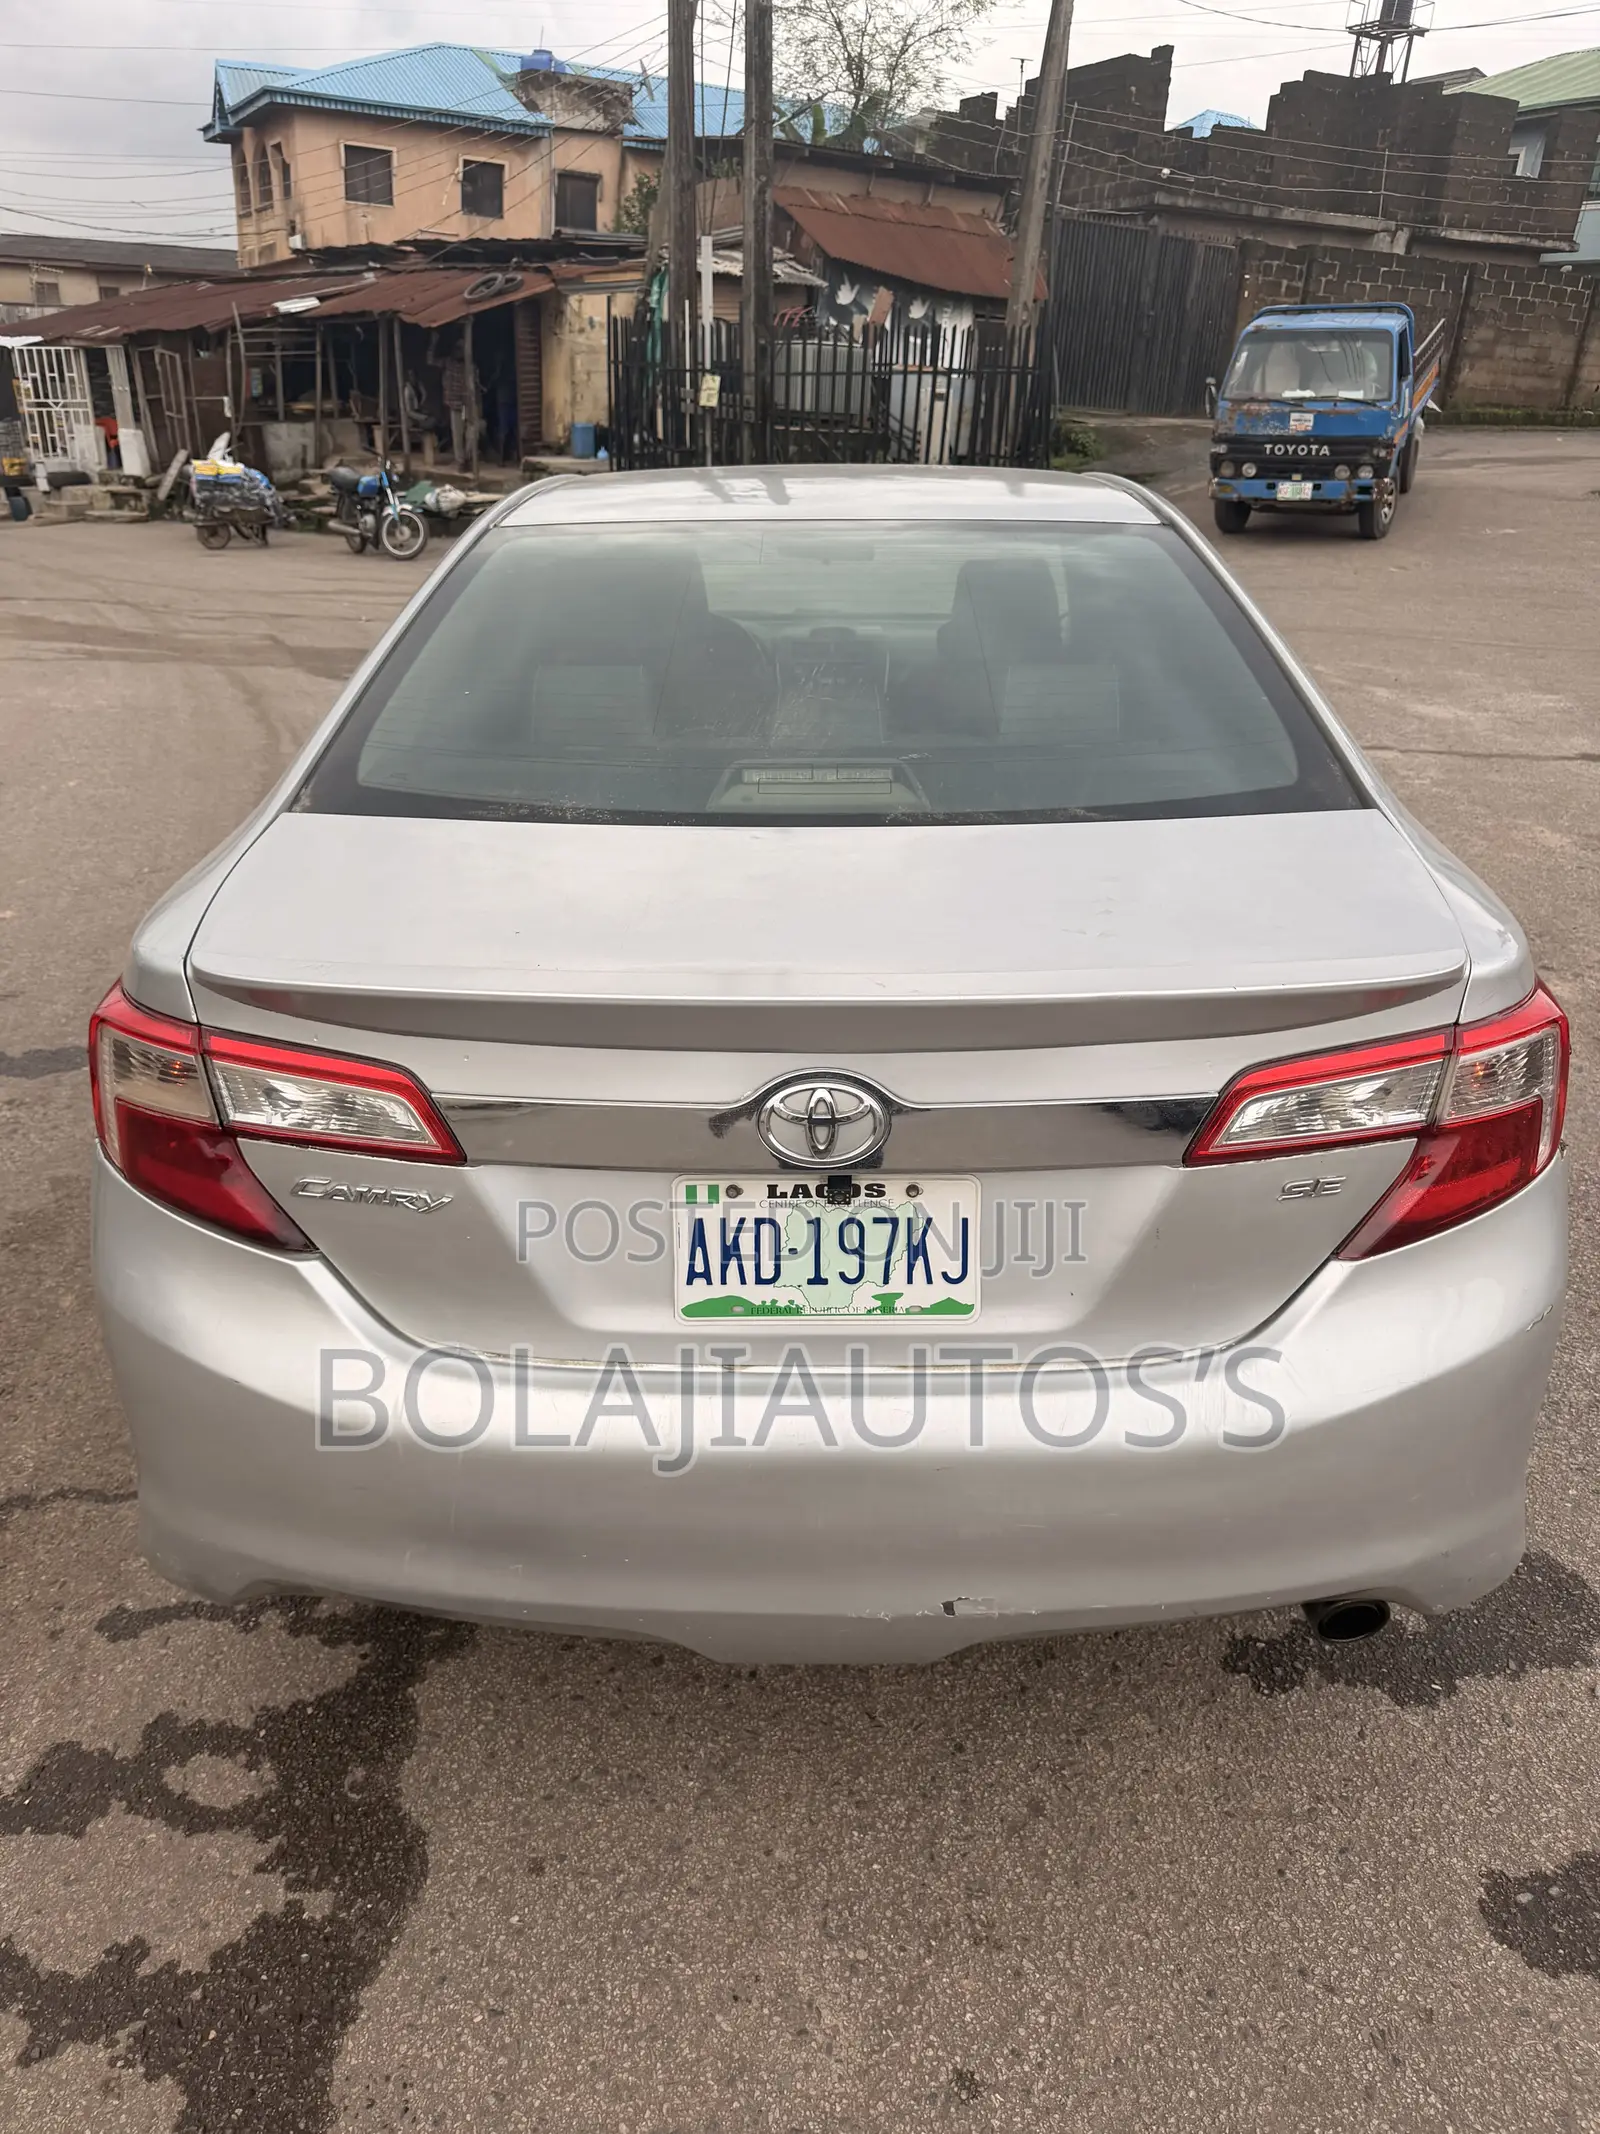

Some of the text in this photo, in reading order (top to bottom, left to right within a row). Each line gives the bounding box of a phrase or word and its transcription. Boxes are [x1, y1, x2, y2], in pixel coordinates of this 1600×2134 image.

[1264, 444, 1330, 456] TOYOTA
[290, 1176, 454, 1215] CAMRY
[1277, 1176, 1347, 1202] SE
[804, 1199, 822, 1209] OF
[686, 1216, 969, 1286] AKD-197KJ
